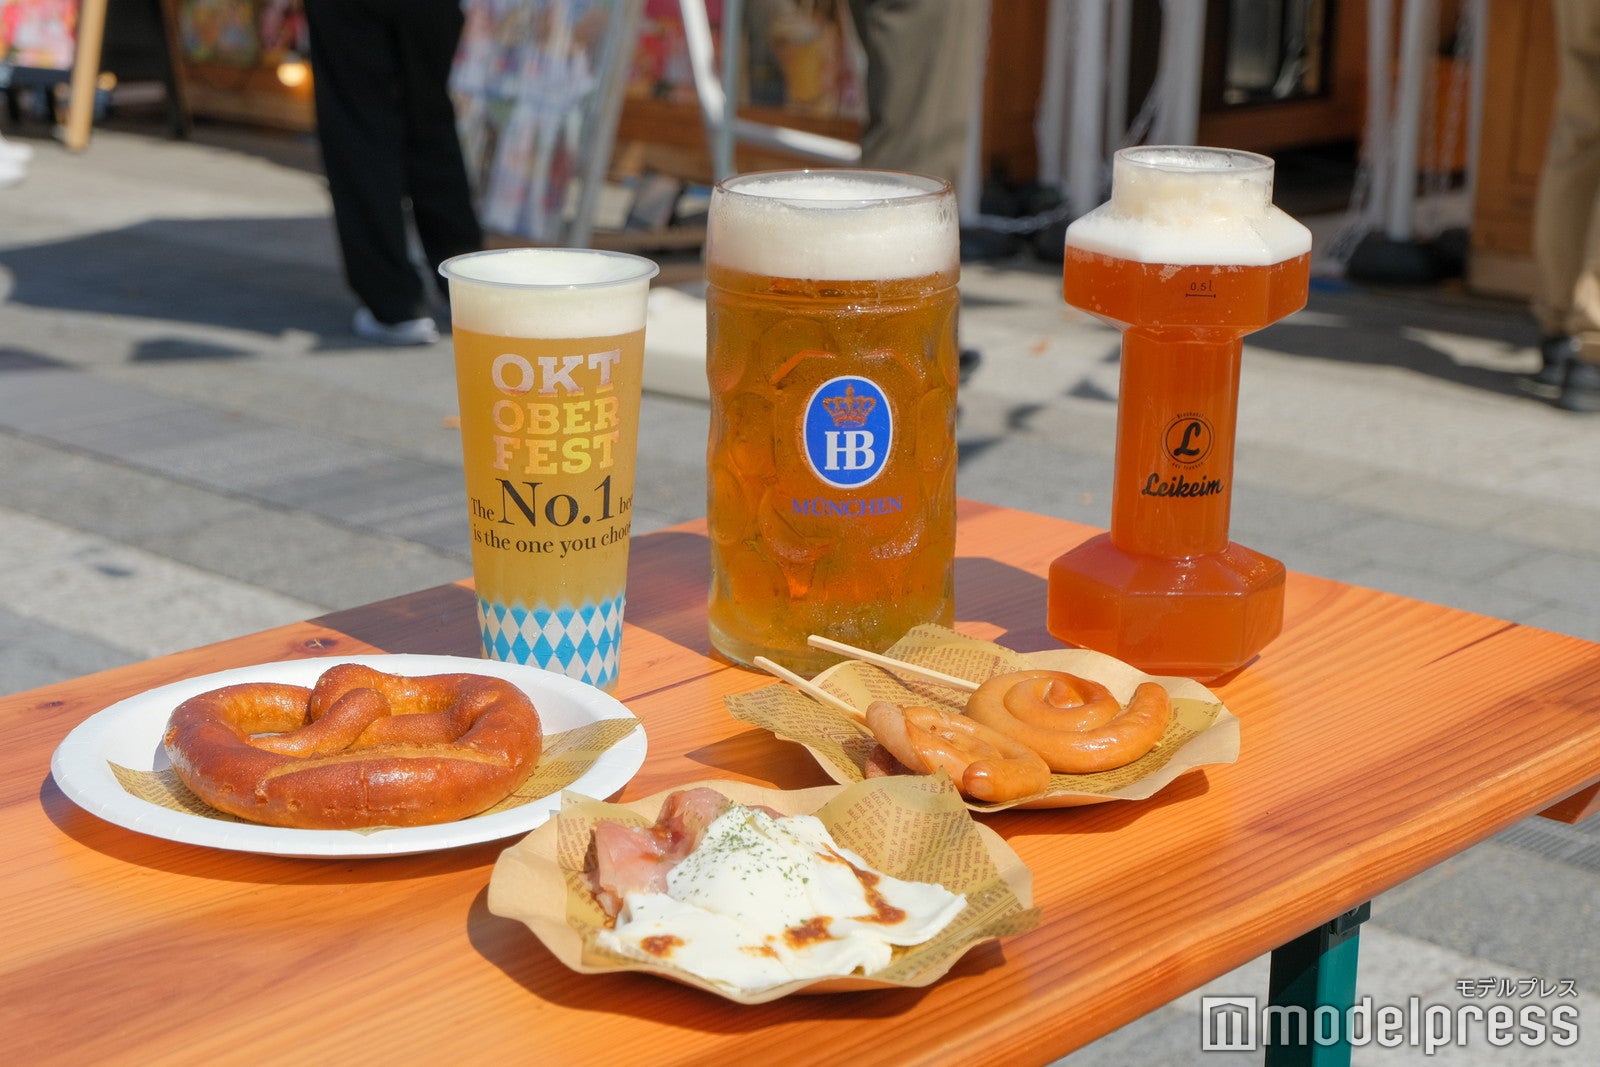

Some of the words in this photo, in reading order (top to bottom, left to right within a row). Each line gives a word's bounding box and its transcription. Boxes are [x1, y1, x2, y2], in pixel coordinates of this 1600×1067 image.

[492, 349, 621, 397] OKT
[492, 396, 620, 435] OBER
[493, 431, 619, 475] FEST
[824, 430, 876, 471] HB
[471, 497, 495, 521] The
[496, 475, 615, 527] No.1
[1141, 472, 1224, 497] Leikeim
[791, 495, 903, 517] MÜNCHEN
[473, 523, 482, 543] is
[484, 530, 510, 551] the
[515, 539, 554, 553] one
[559, 538, 597, 558] you
